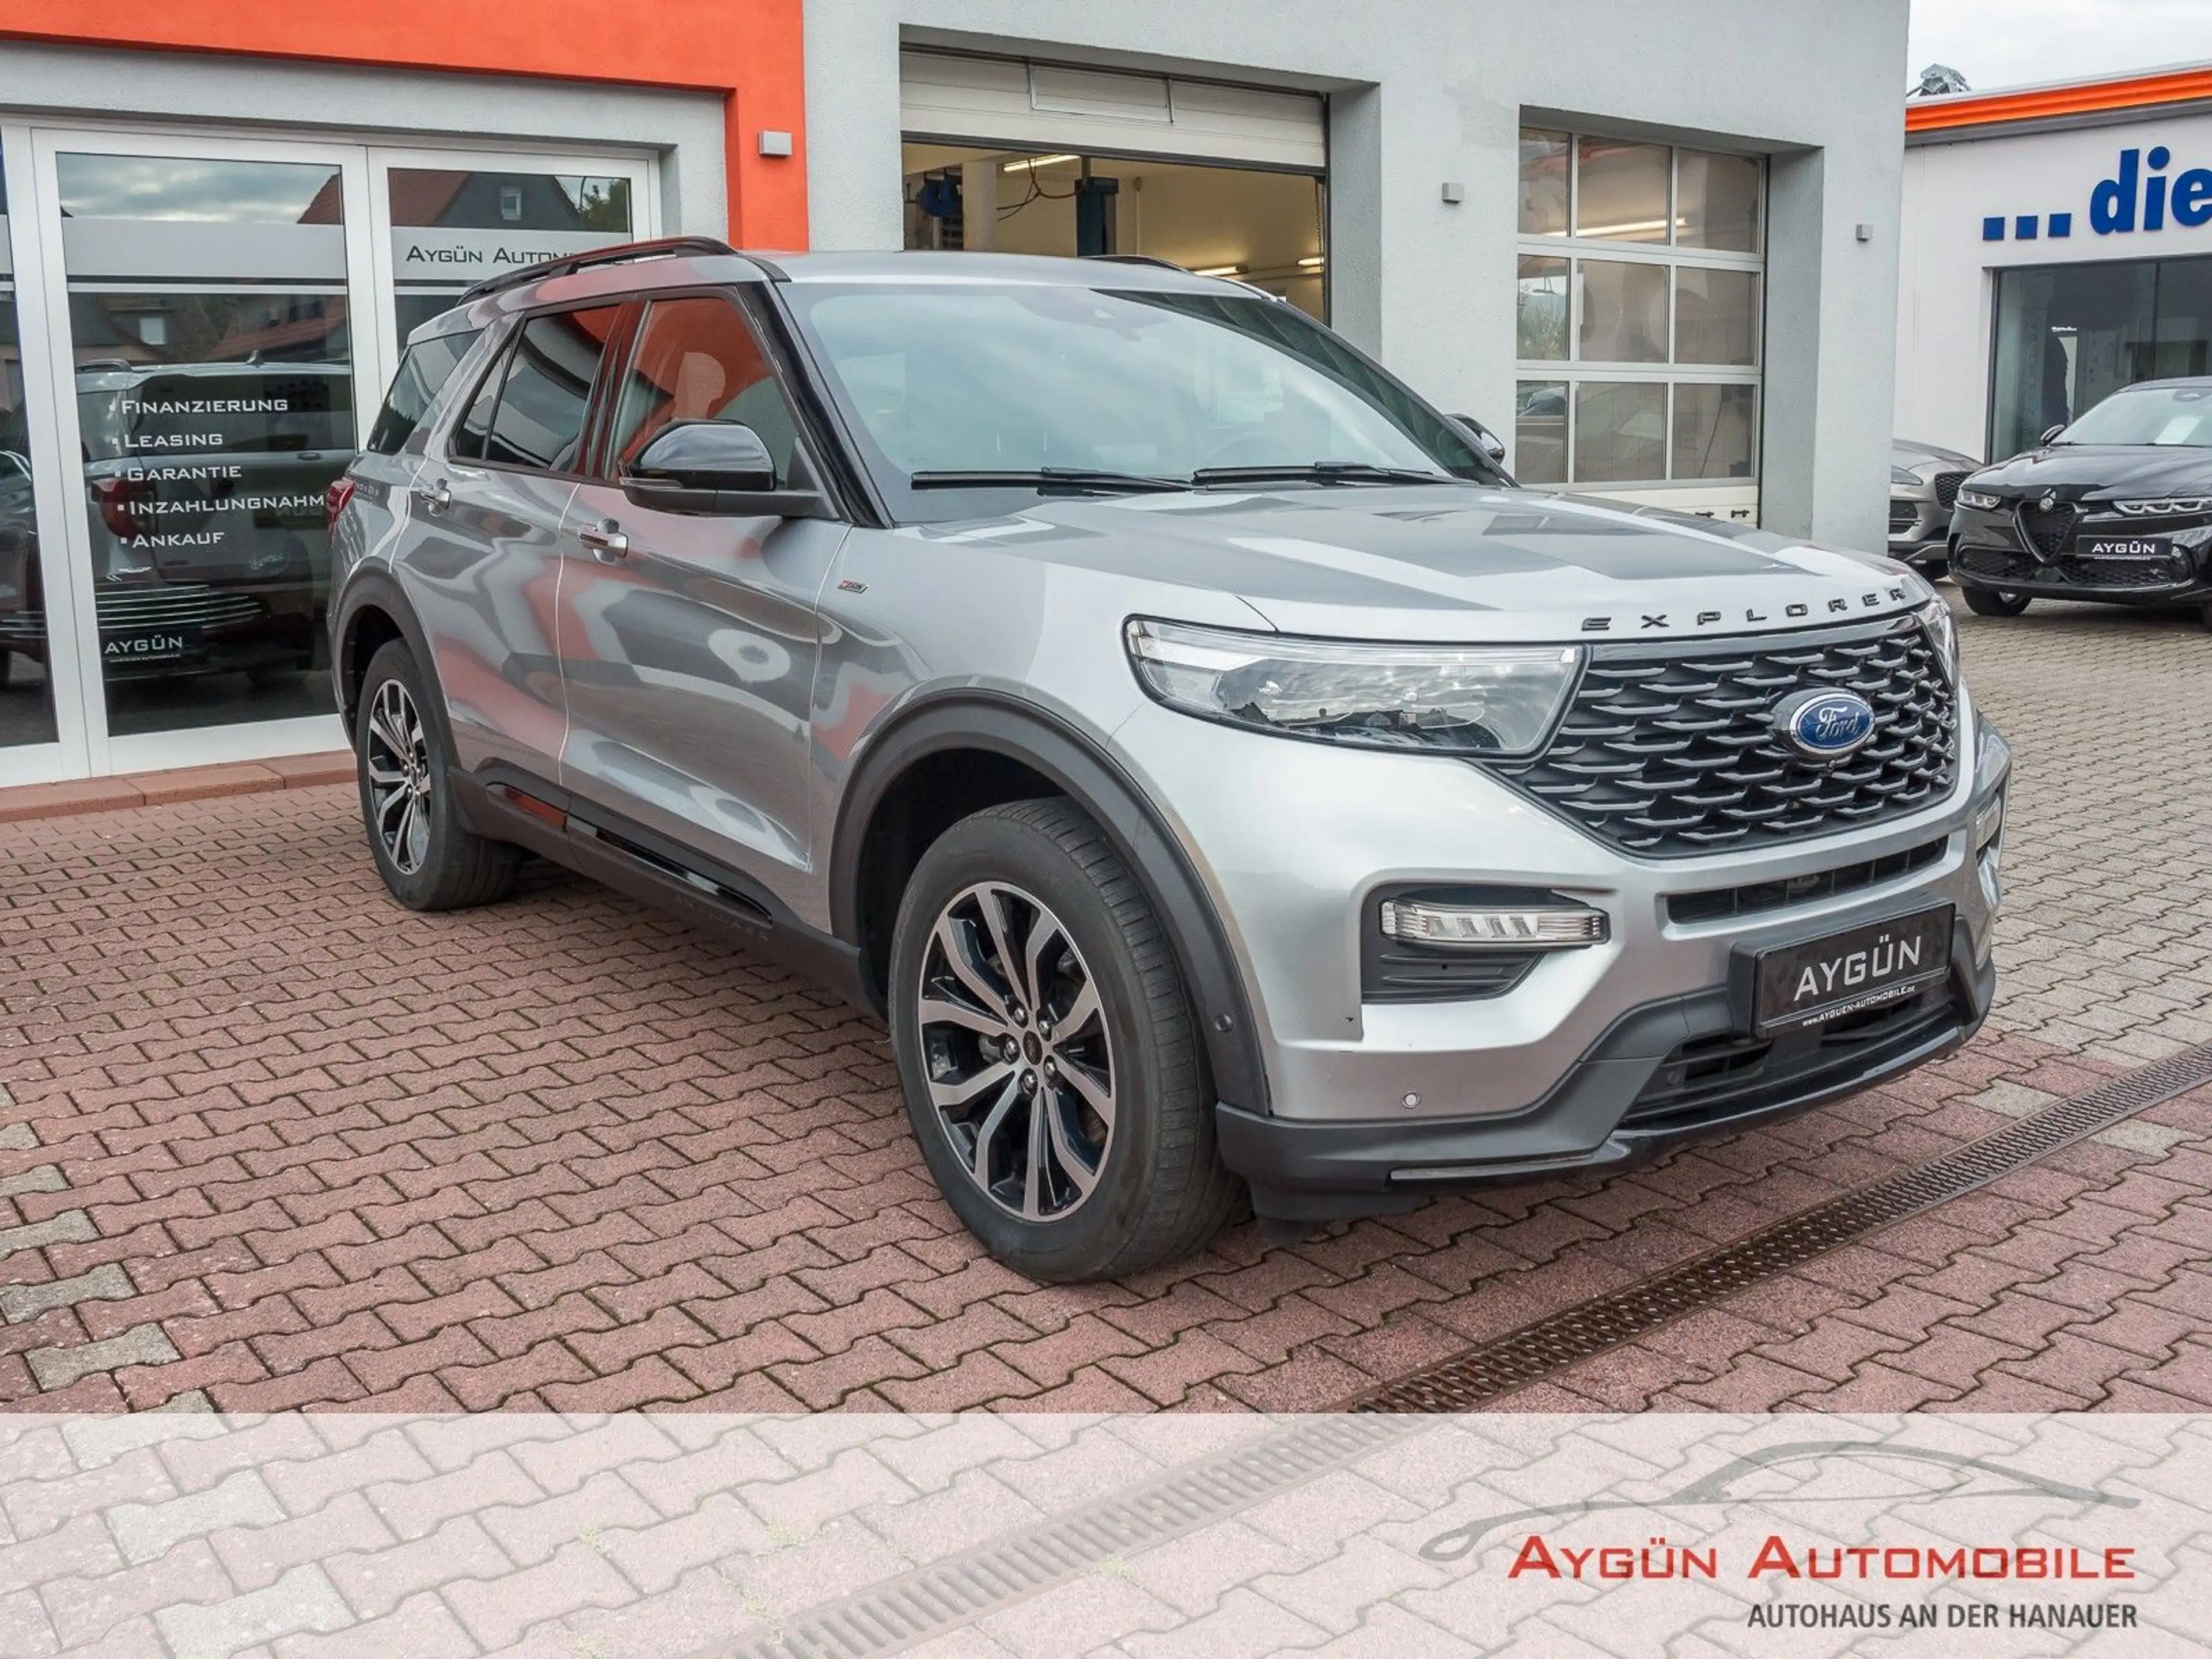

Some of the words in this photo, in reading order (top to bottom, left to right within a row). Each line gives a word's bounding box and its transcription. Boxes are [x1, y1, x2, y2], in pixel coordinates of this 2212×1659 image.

[406, 245, 483, 264] AYGÜN
[121, 399, 288, 414] FINANZIERUNG
[124, 434, 224, 448] LEASING
[128, 465, 243, 481] GARANTIE
[129, 494, 325, 515] INZAHLUNGNAHM
[132, 532, 225, 548] ANKAUF
[2091, 540, 2155, 554] AYGÜN
[1581, 586, 1906, 631] EXPLORER
[104, 634, 183, 654] AYGÜN
[1816, 706, 1860, 741] Ford
[1793, 934, 1922, 1002] AYGÜN
